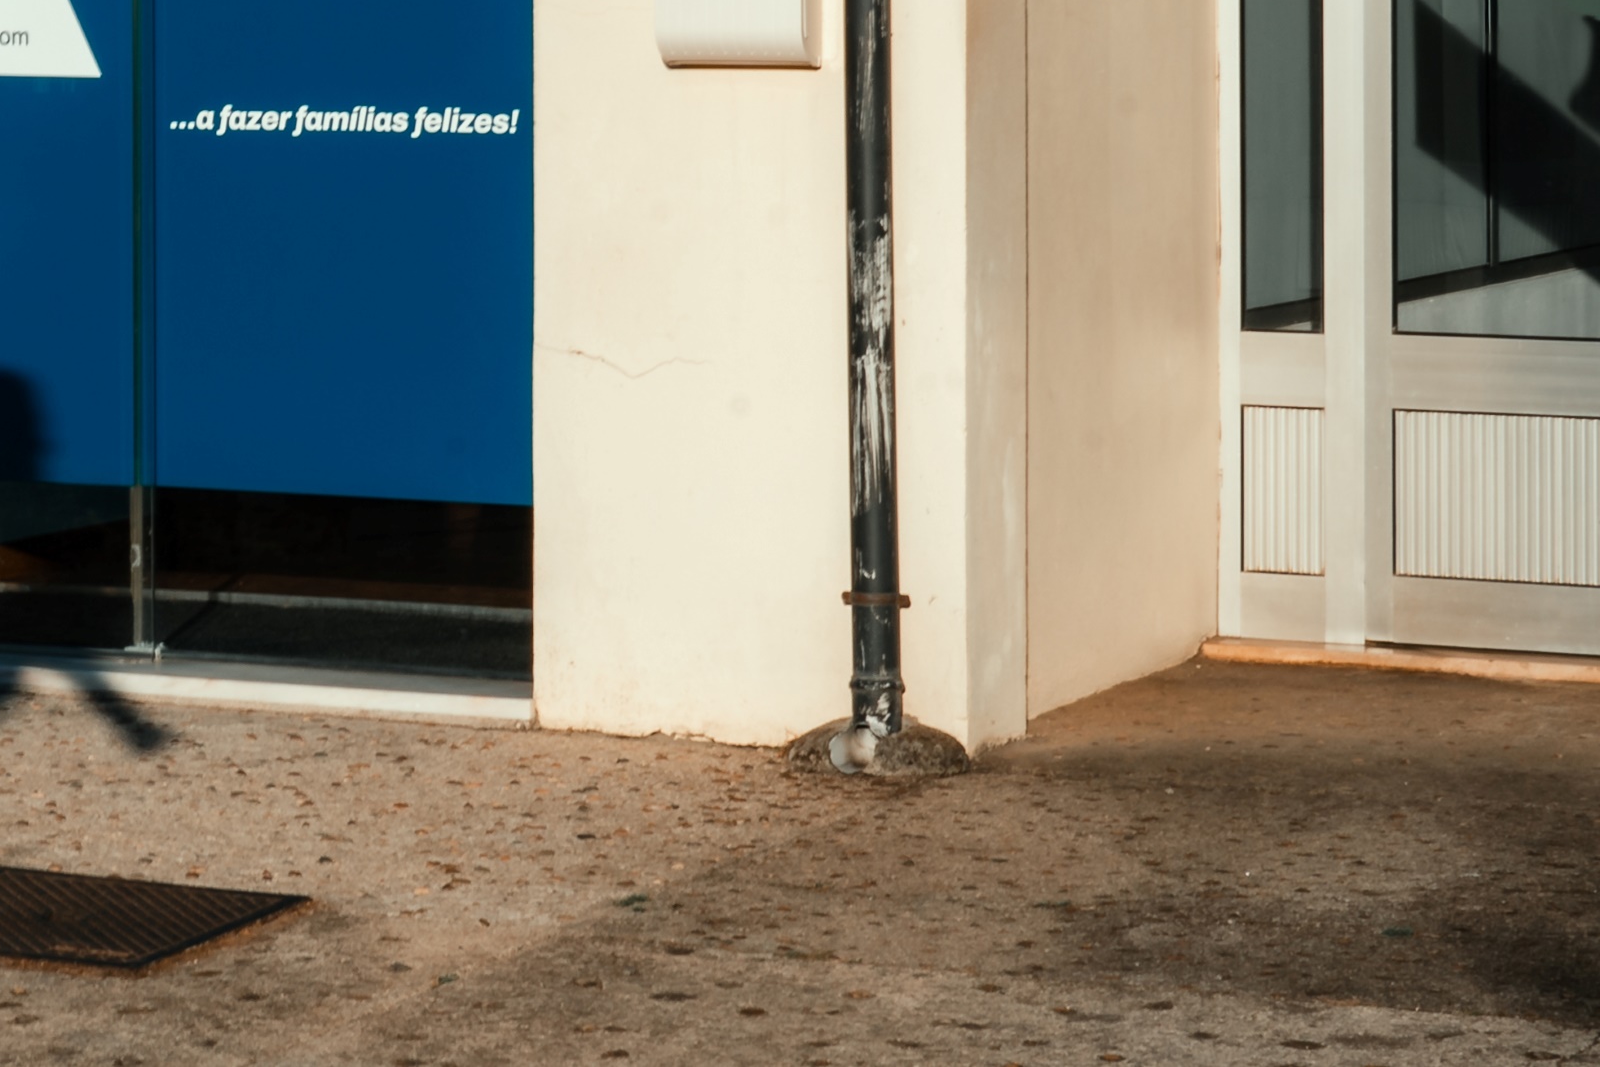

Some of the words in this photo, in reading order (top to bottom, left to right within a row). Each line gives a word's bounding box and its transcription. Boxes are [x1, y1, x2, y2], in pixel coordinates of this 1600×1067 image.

[215, 104, 292, 136] fazer
[291, 105, 409, 137] famílias
[410, 106, 520, 139] felizes!
